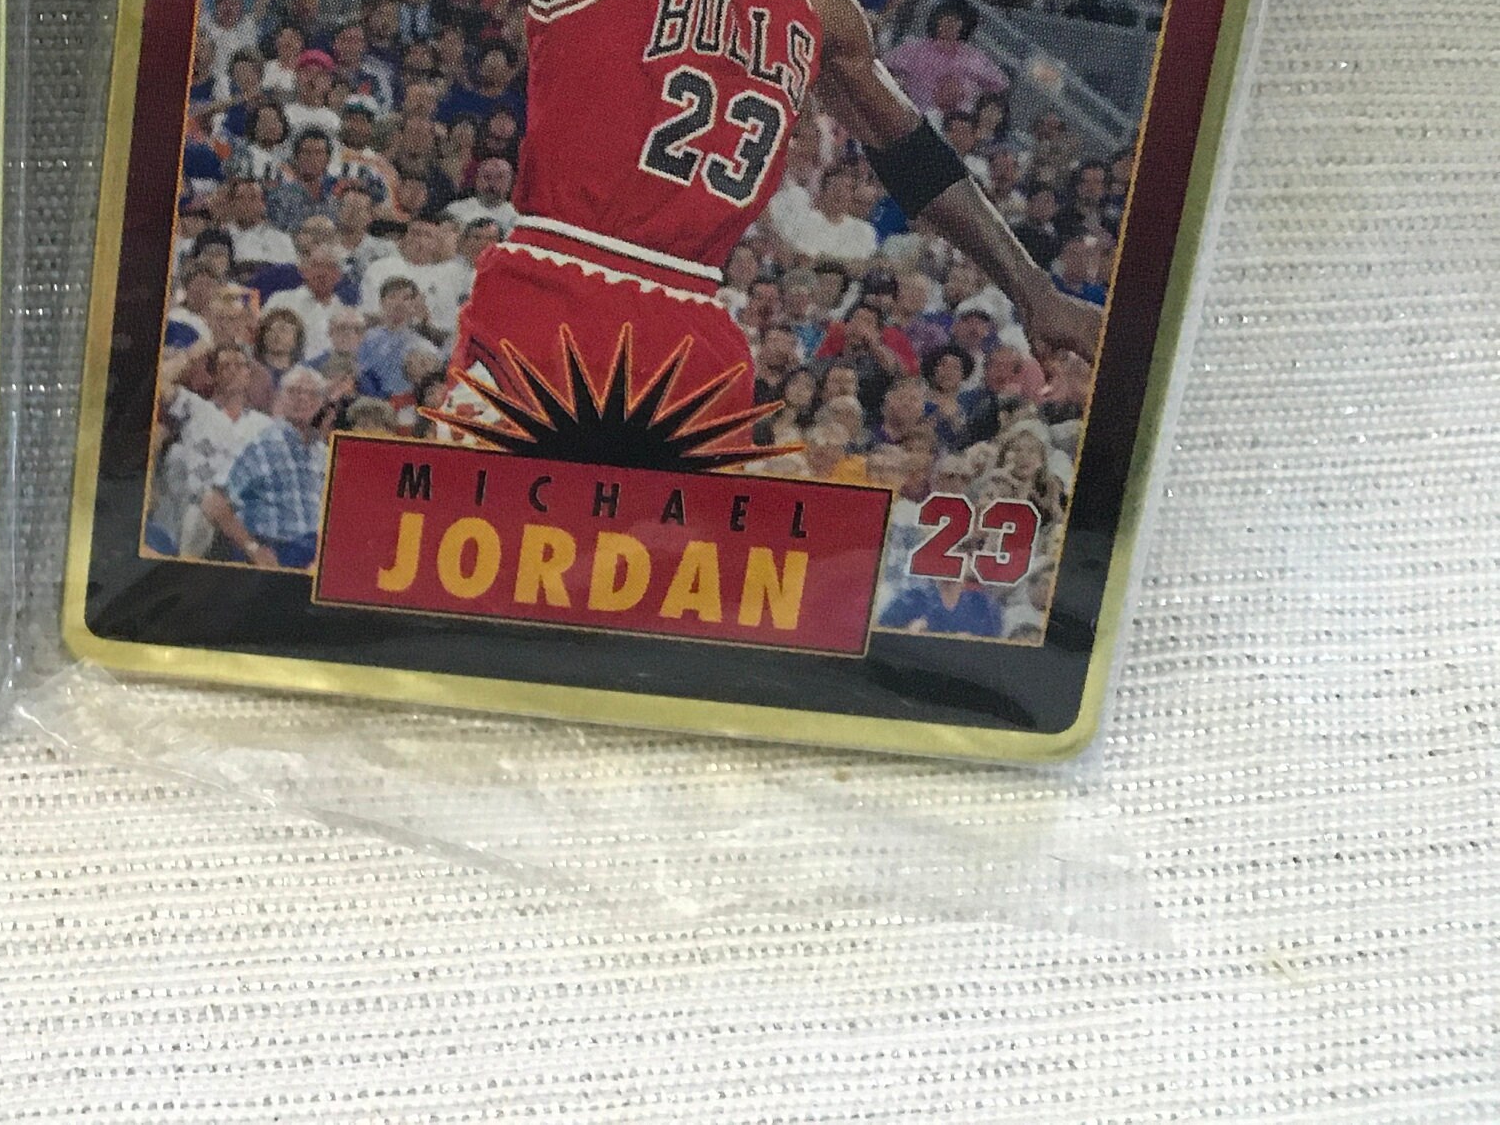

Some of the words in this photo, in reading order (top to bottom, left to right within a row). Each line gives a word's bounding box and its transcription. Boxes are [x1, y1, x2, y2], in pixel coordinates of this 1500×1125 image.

[638, 65, 787, 207] 23
[398, 462, 807, 538] MICHAEL
[908, 492, 1043, 587] 23
[377, 513, 808, 630] JORDAN
